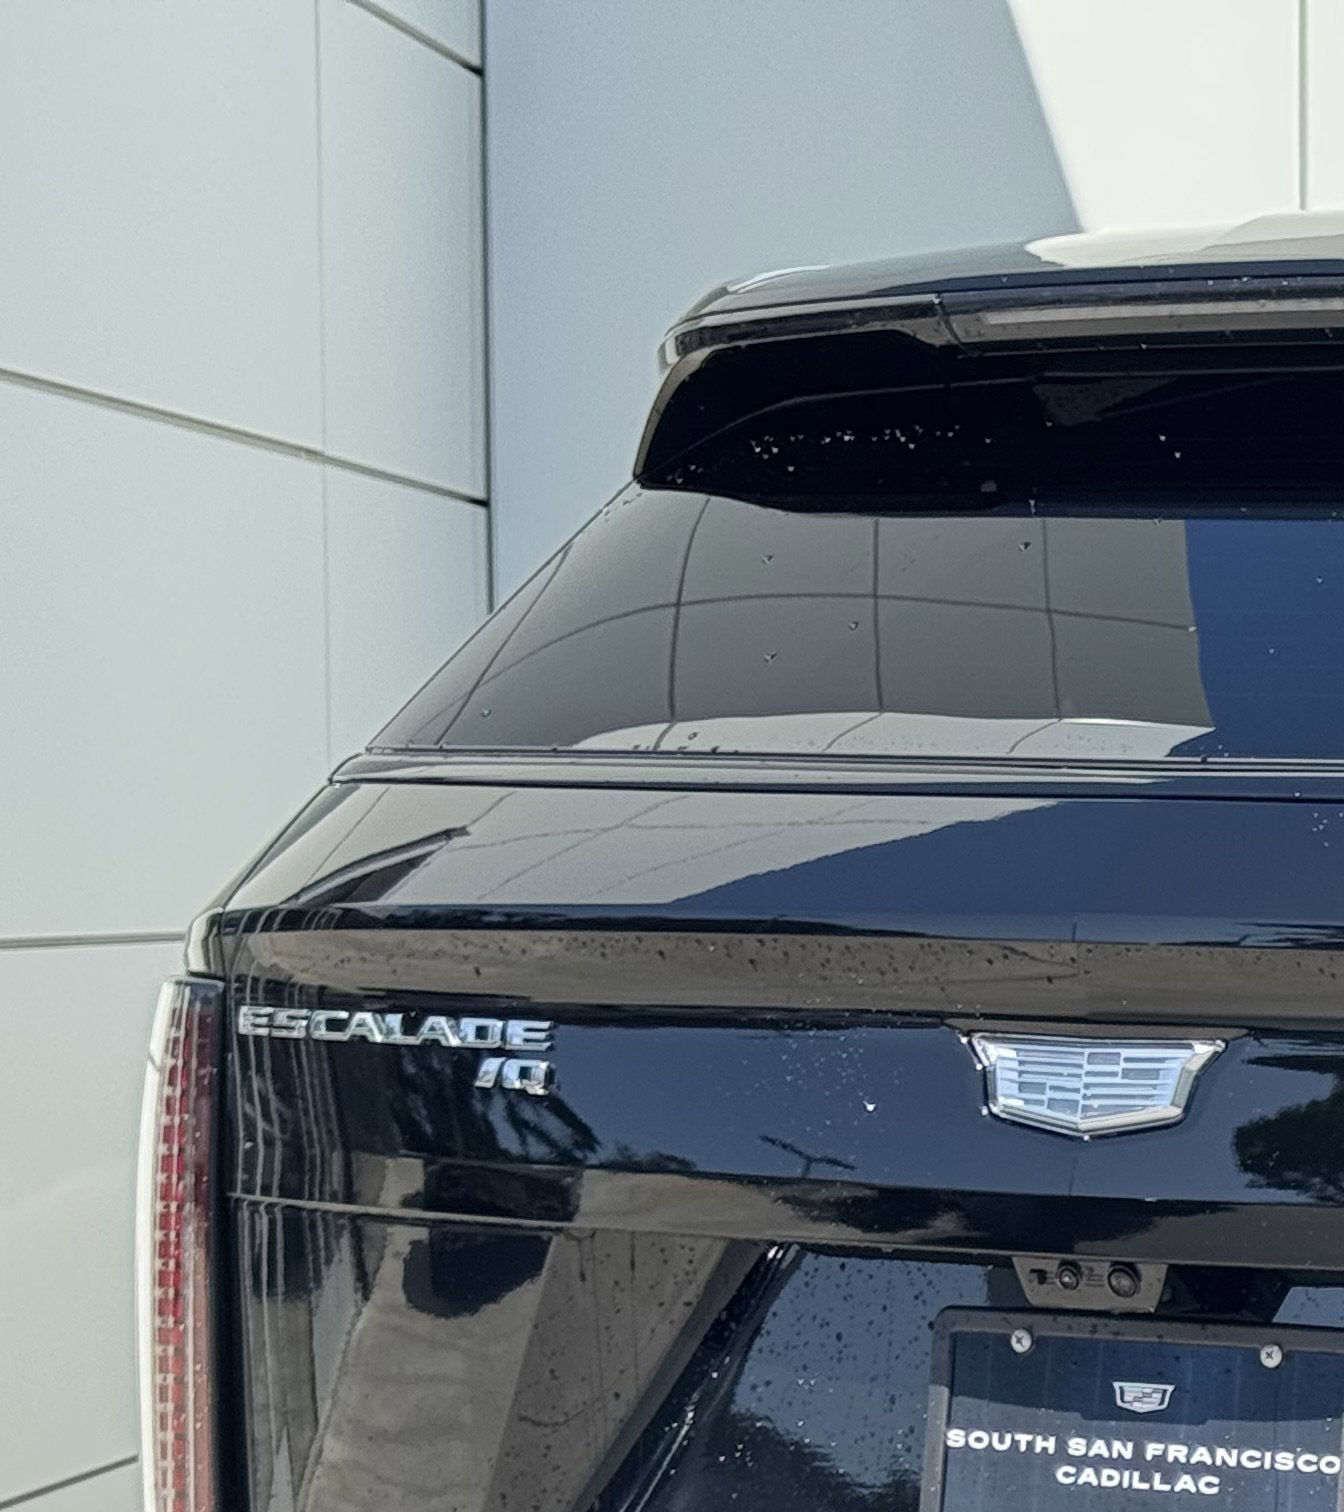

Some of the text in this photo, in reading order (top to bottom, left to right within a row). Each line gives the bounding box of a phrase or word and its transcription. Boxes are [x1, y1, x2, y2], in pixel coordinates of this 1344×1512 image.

[238, 1004, 554, 1052] ESCALADE
[474, 1056, 556, 1096] IQ
[946, 1428, 1342, 1475] SOUTH SAN FRANCISCO
[1055, 1465, 1221, 1495] CADILLAC
